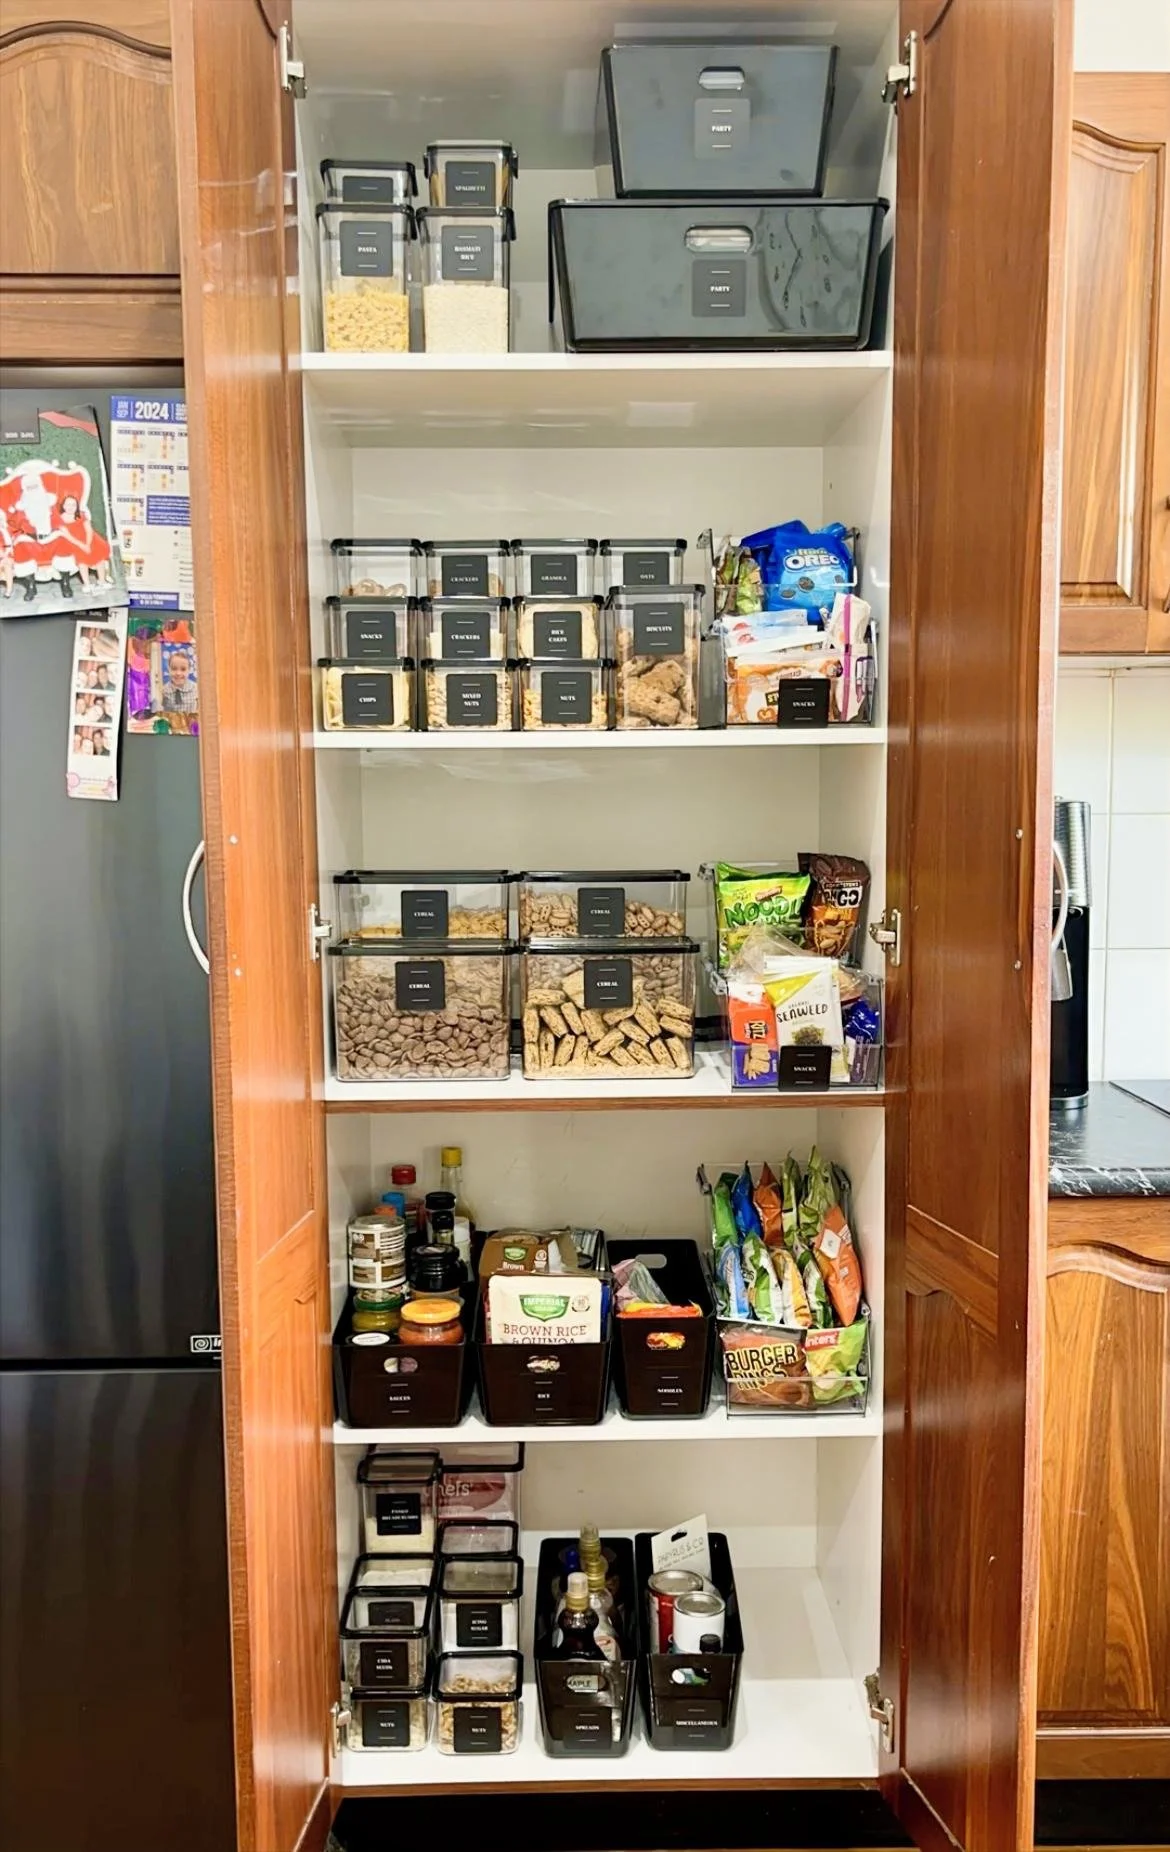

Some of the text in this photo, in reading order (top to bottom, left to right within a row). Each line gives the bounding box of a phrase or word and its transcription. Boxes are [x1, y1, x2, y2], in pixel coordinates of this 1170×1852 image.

[135, 401, 169, 420] 2024
[785, 554, 840, 570] OREO
[776, 1004, 828, 1023] SEAWEED
[503, 1261, 525, 1270] Brown
[503, 1323, 588, 1337] BROWN RICE
[725, 1344, 798, 1371] BURGER
